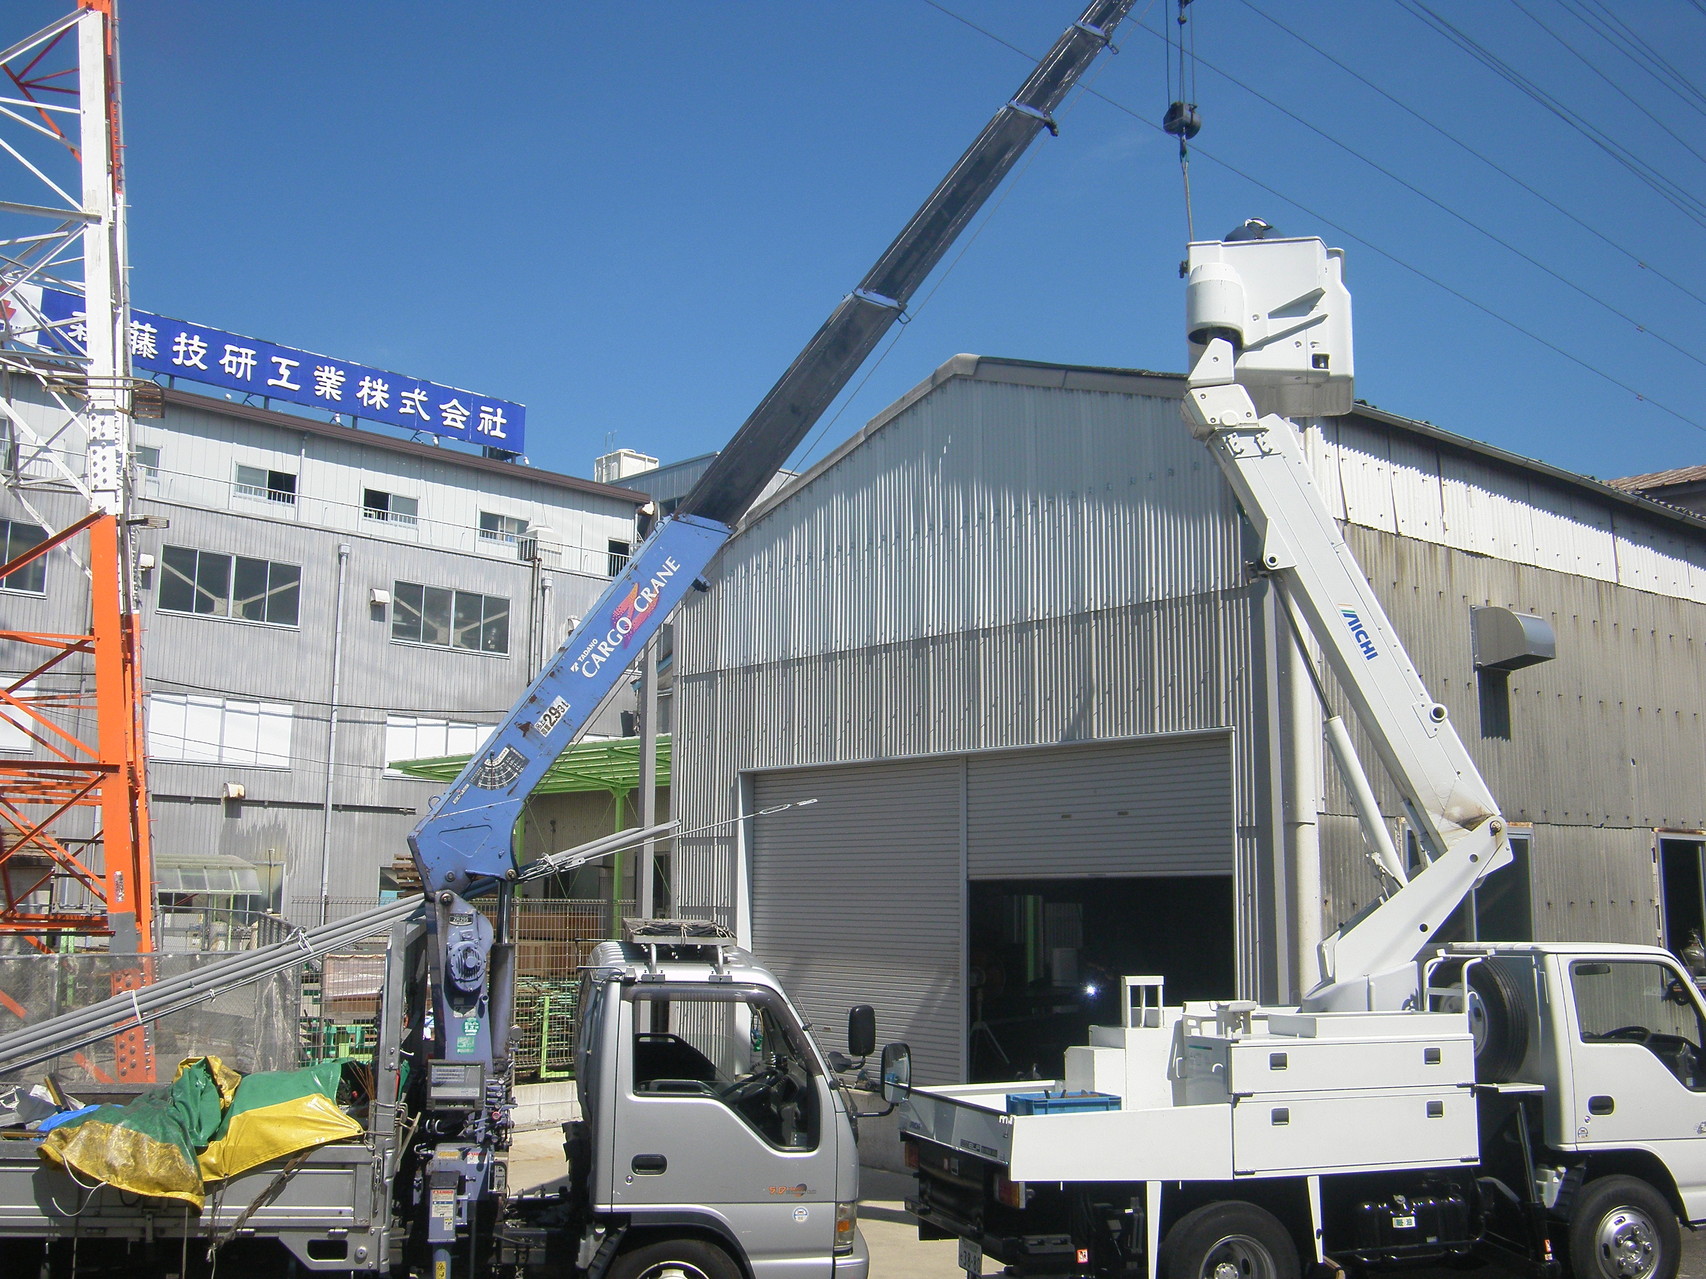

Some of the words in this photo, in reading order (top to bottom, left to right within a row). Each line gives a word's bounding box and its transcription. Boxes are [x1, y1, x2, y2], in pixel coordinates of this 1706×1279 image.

[581, 616, 633, 679] CARGO
[633, 556, 681, 613] CRANE
[1342, 610, 1379, 661] AICHI
[577, 638, 598, 662] TADANO
